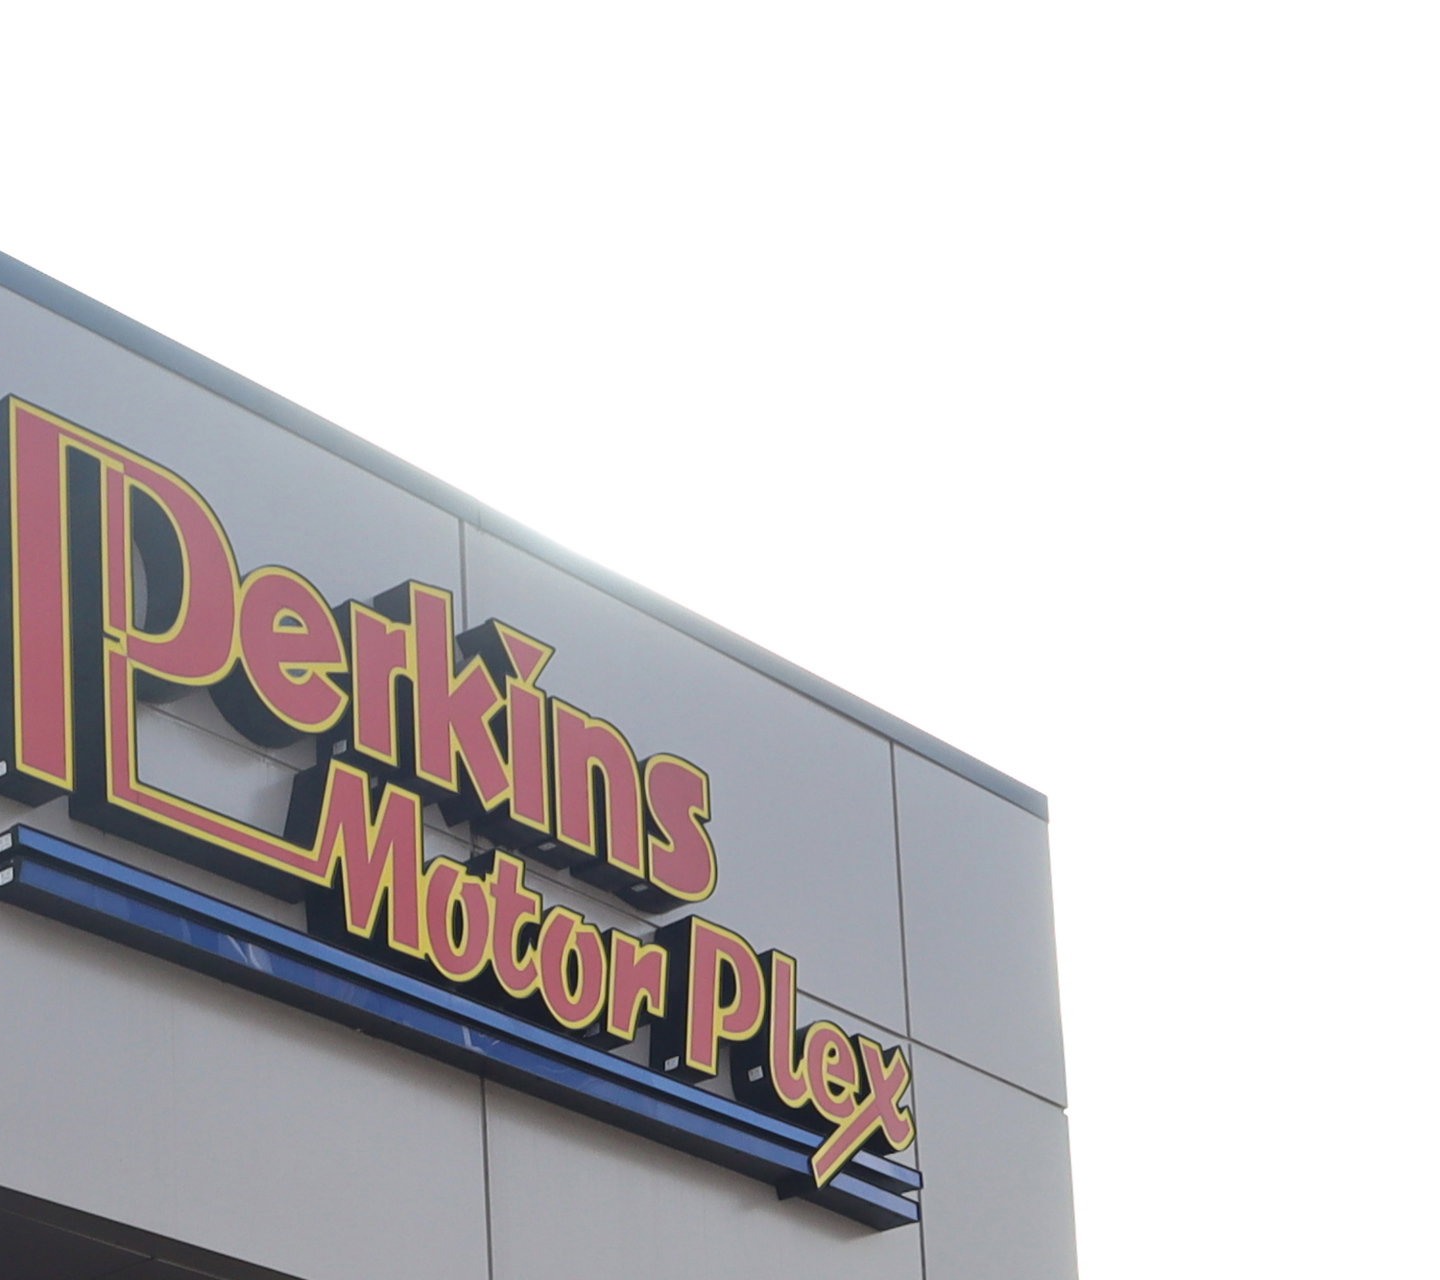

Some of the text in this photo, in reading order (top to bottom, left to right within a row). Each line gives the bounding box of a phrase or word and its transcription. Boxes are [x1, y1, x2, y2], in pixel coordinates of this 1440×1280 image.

[9, 395, 717, 902] Perkins
[318, 757, 916, 1187] Motor Plex
